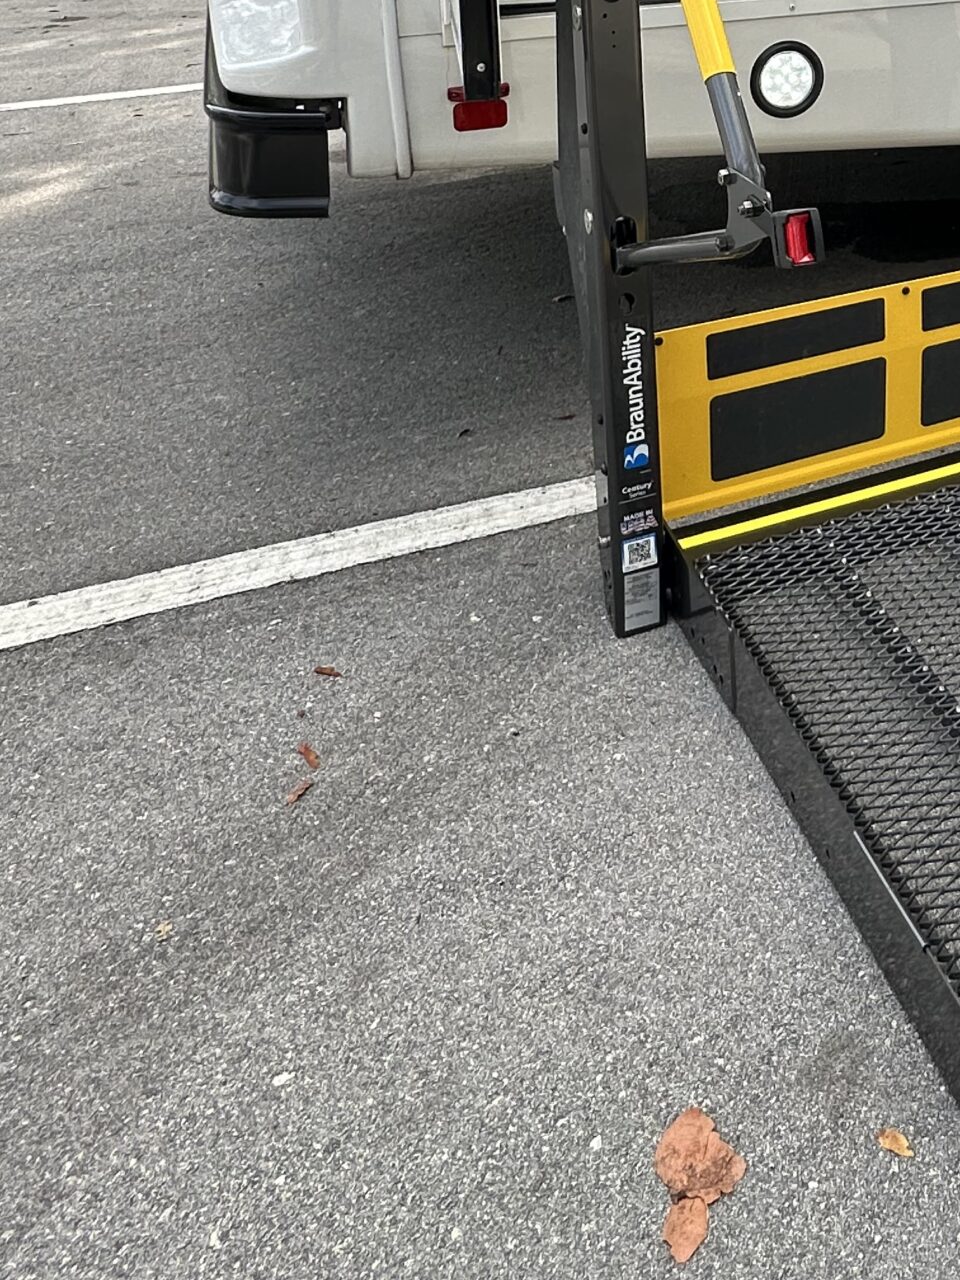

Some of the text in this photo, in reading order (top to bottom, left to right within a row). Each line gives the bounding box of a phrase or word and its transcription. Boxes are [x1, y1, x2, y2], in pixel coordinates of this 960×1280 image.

[622, 326, 646, 444] BraunAbility
[621, 482, 652, 495] Century
[623, 508, 653, 522] MADE IN
